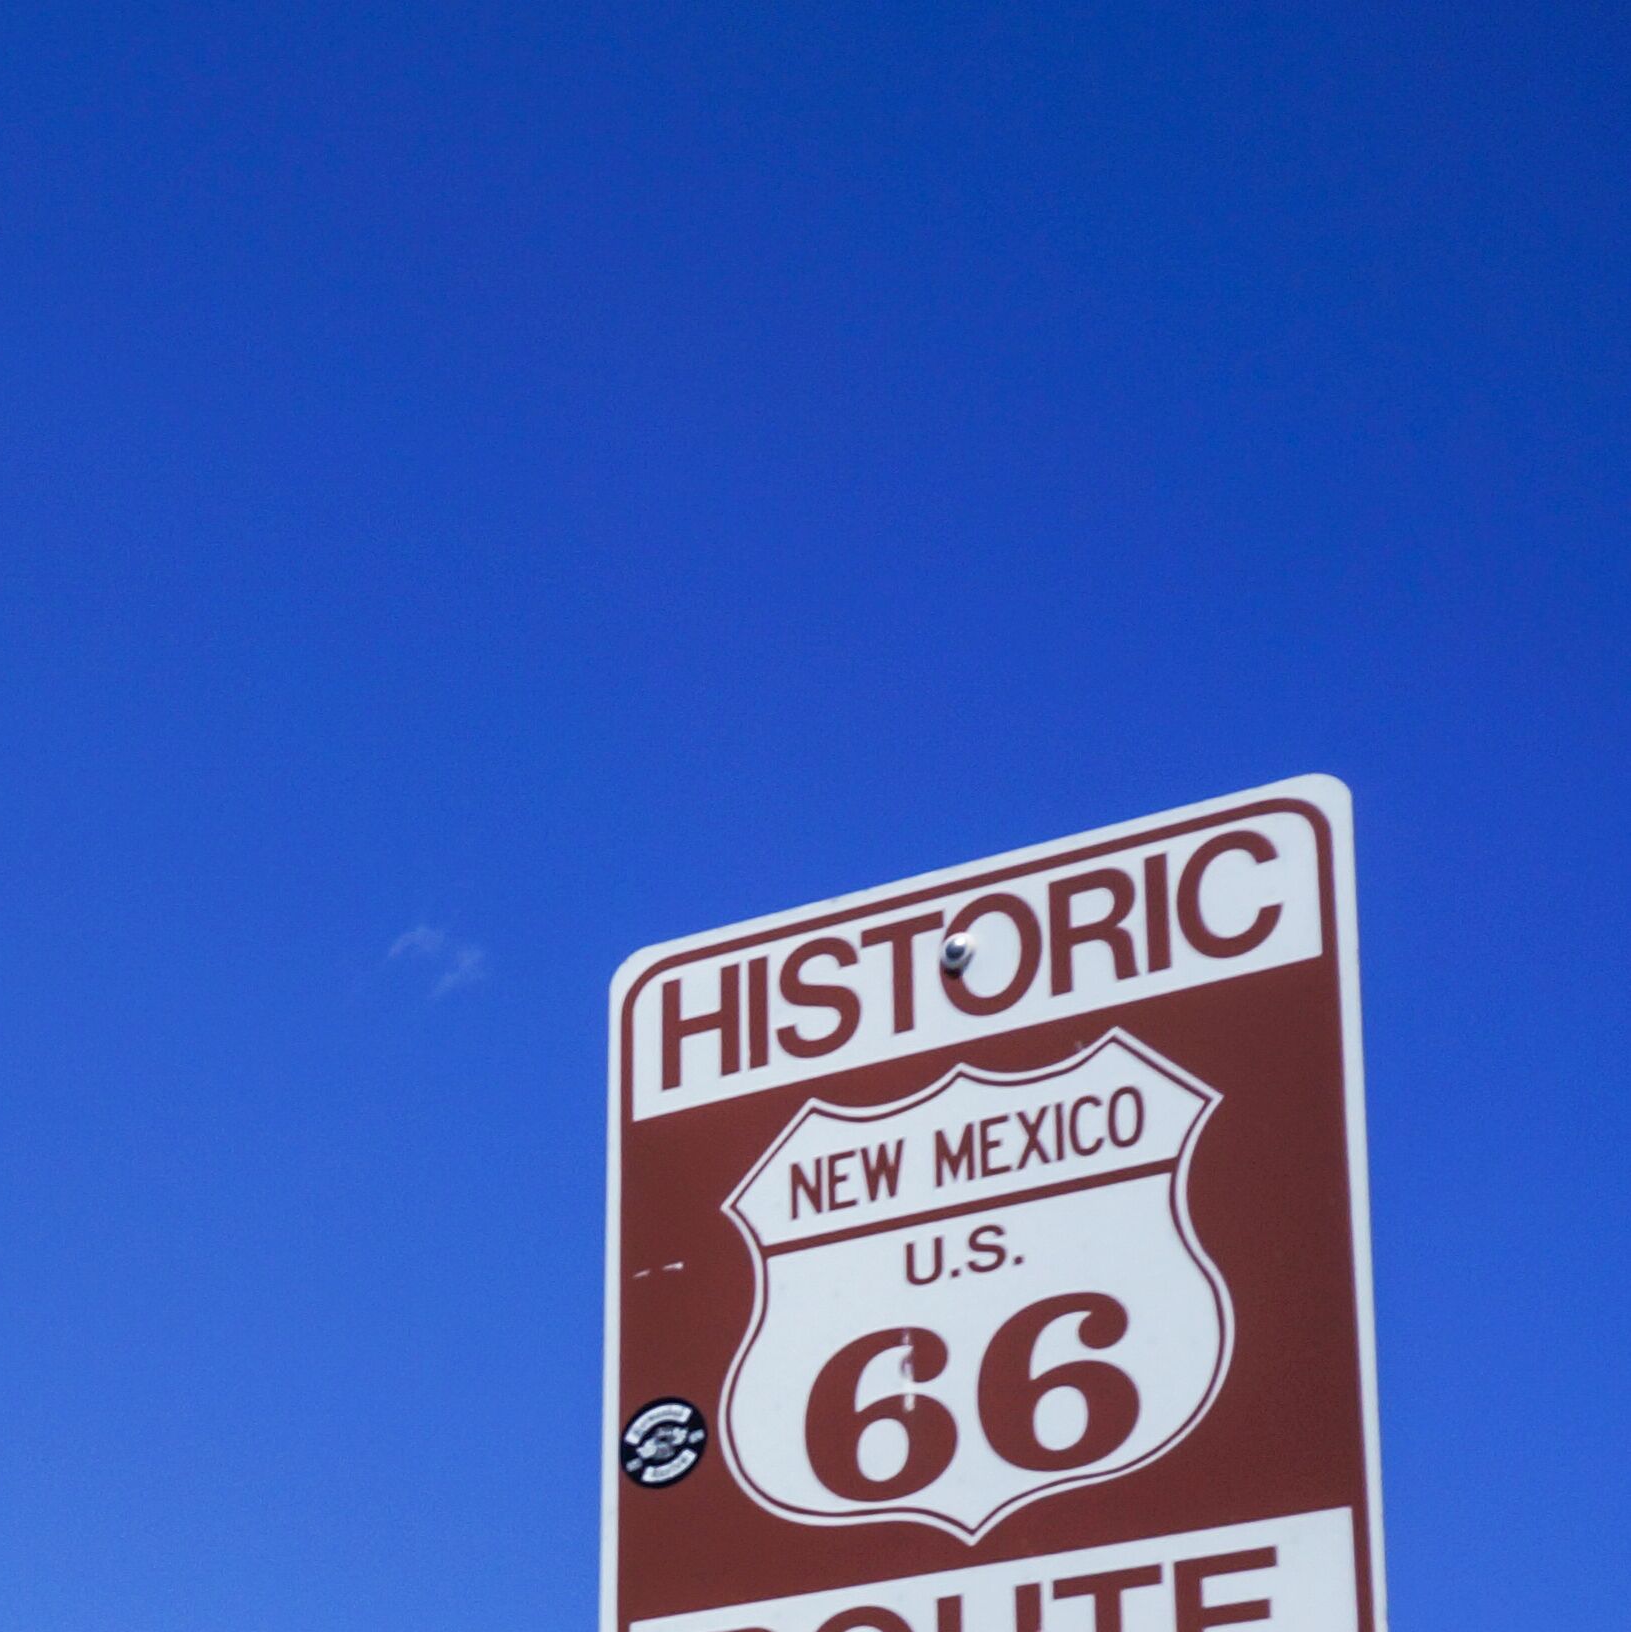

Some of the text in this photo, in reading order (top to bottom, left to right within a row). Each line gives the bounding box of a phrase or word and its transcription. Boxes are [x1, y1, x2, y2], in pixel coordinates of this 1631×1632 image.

[660, 830, 1282, 1091] HISTORIC
[790, 1086, 1145, 1220] NEW MEXICO
[904, 1224, 1024, 1285] U.S.
[806, 1292, 1140, 1502] 66
